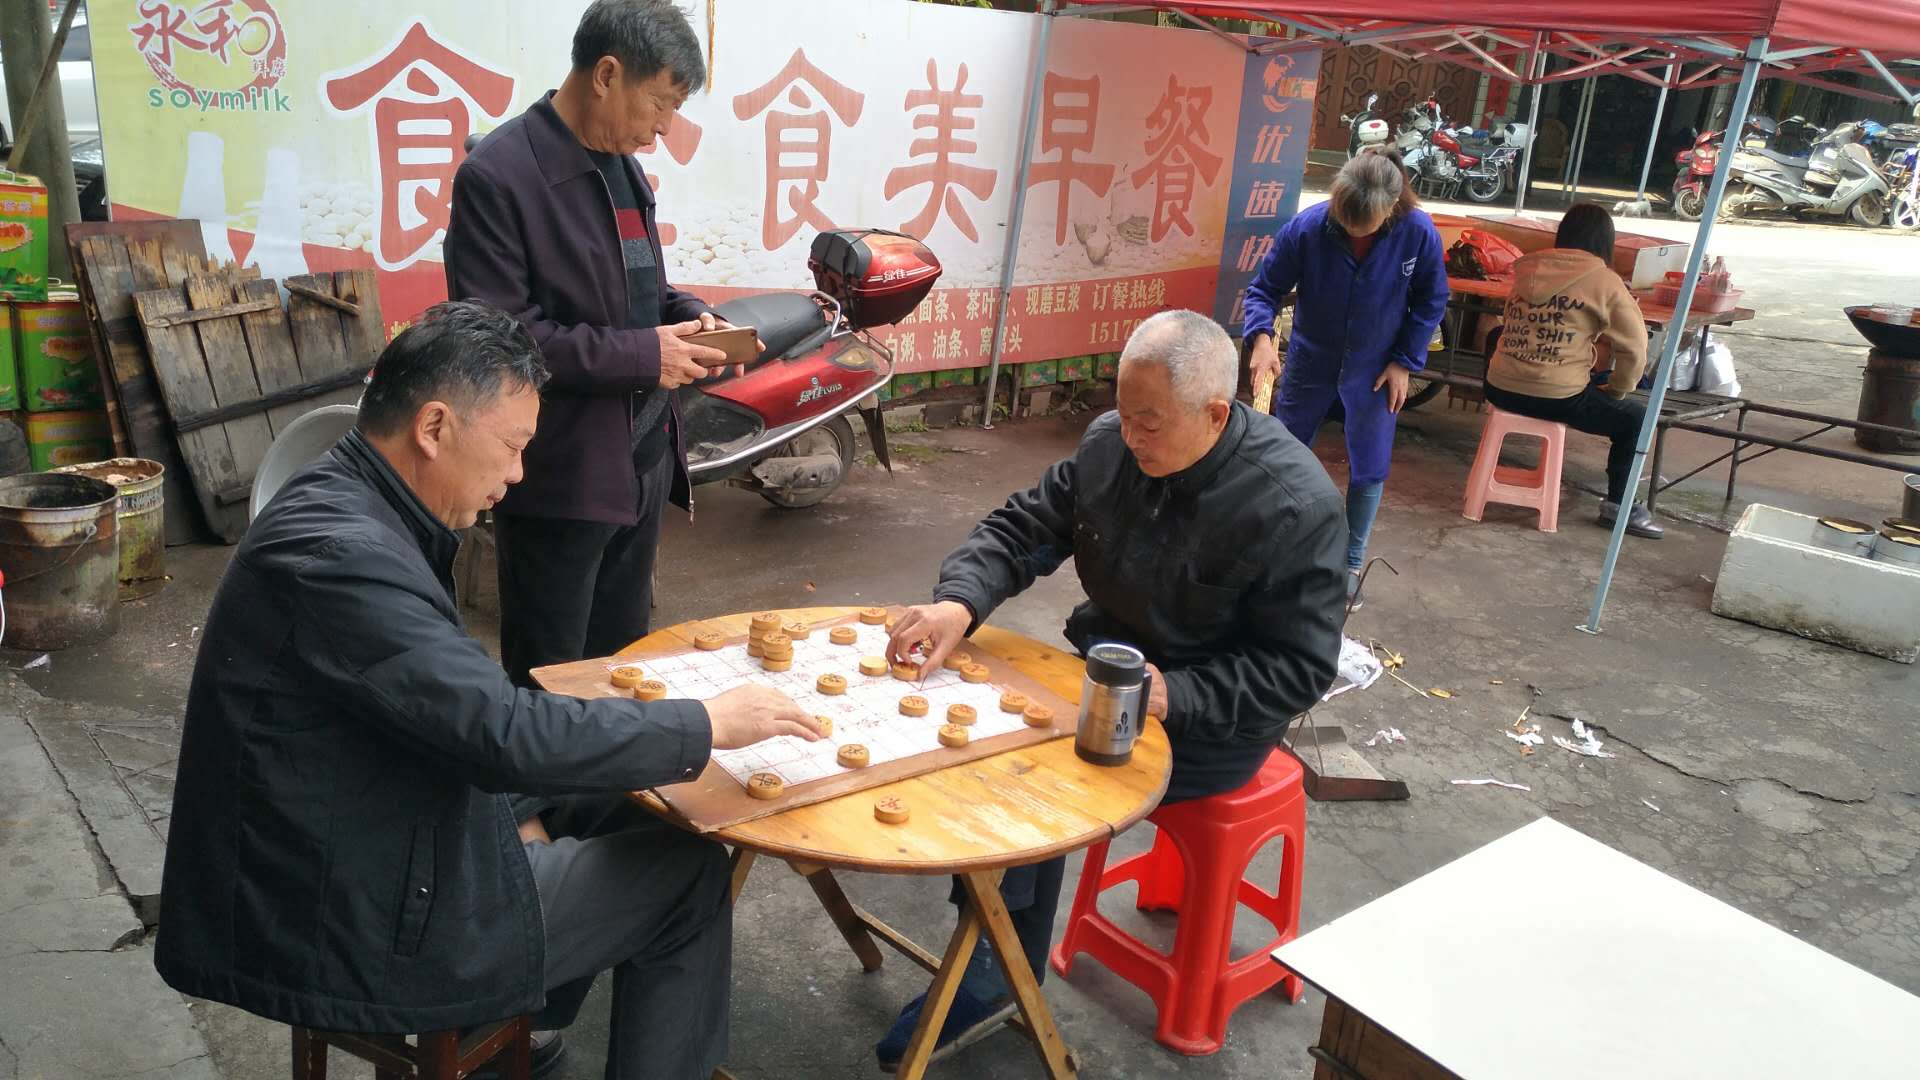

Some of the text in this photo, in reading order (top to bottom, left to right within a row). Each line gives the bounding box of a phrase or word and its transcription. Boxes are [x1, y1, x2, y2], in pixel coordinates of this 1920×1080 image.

[149, 88, 291, 112] soymilk
[325, 22, 1224, 260] 食食美早餐
[1229, 123, 1294, 326] 优速快
[1091, 277, 1166, 313] 订餐热线
[1527, 311, 1565, 326] OUR
[884, 322, 1024, 364] 白粥、油条、窝头
[1536, 327, 1576, 344] SHIT
[1536, 343, 1561, 357] THE
